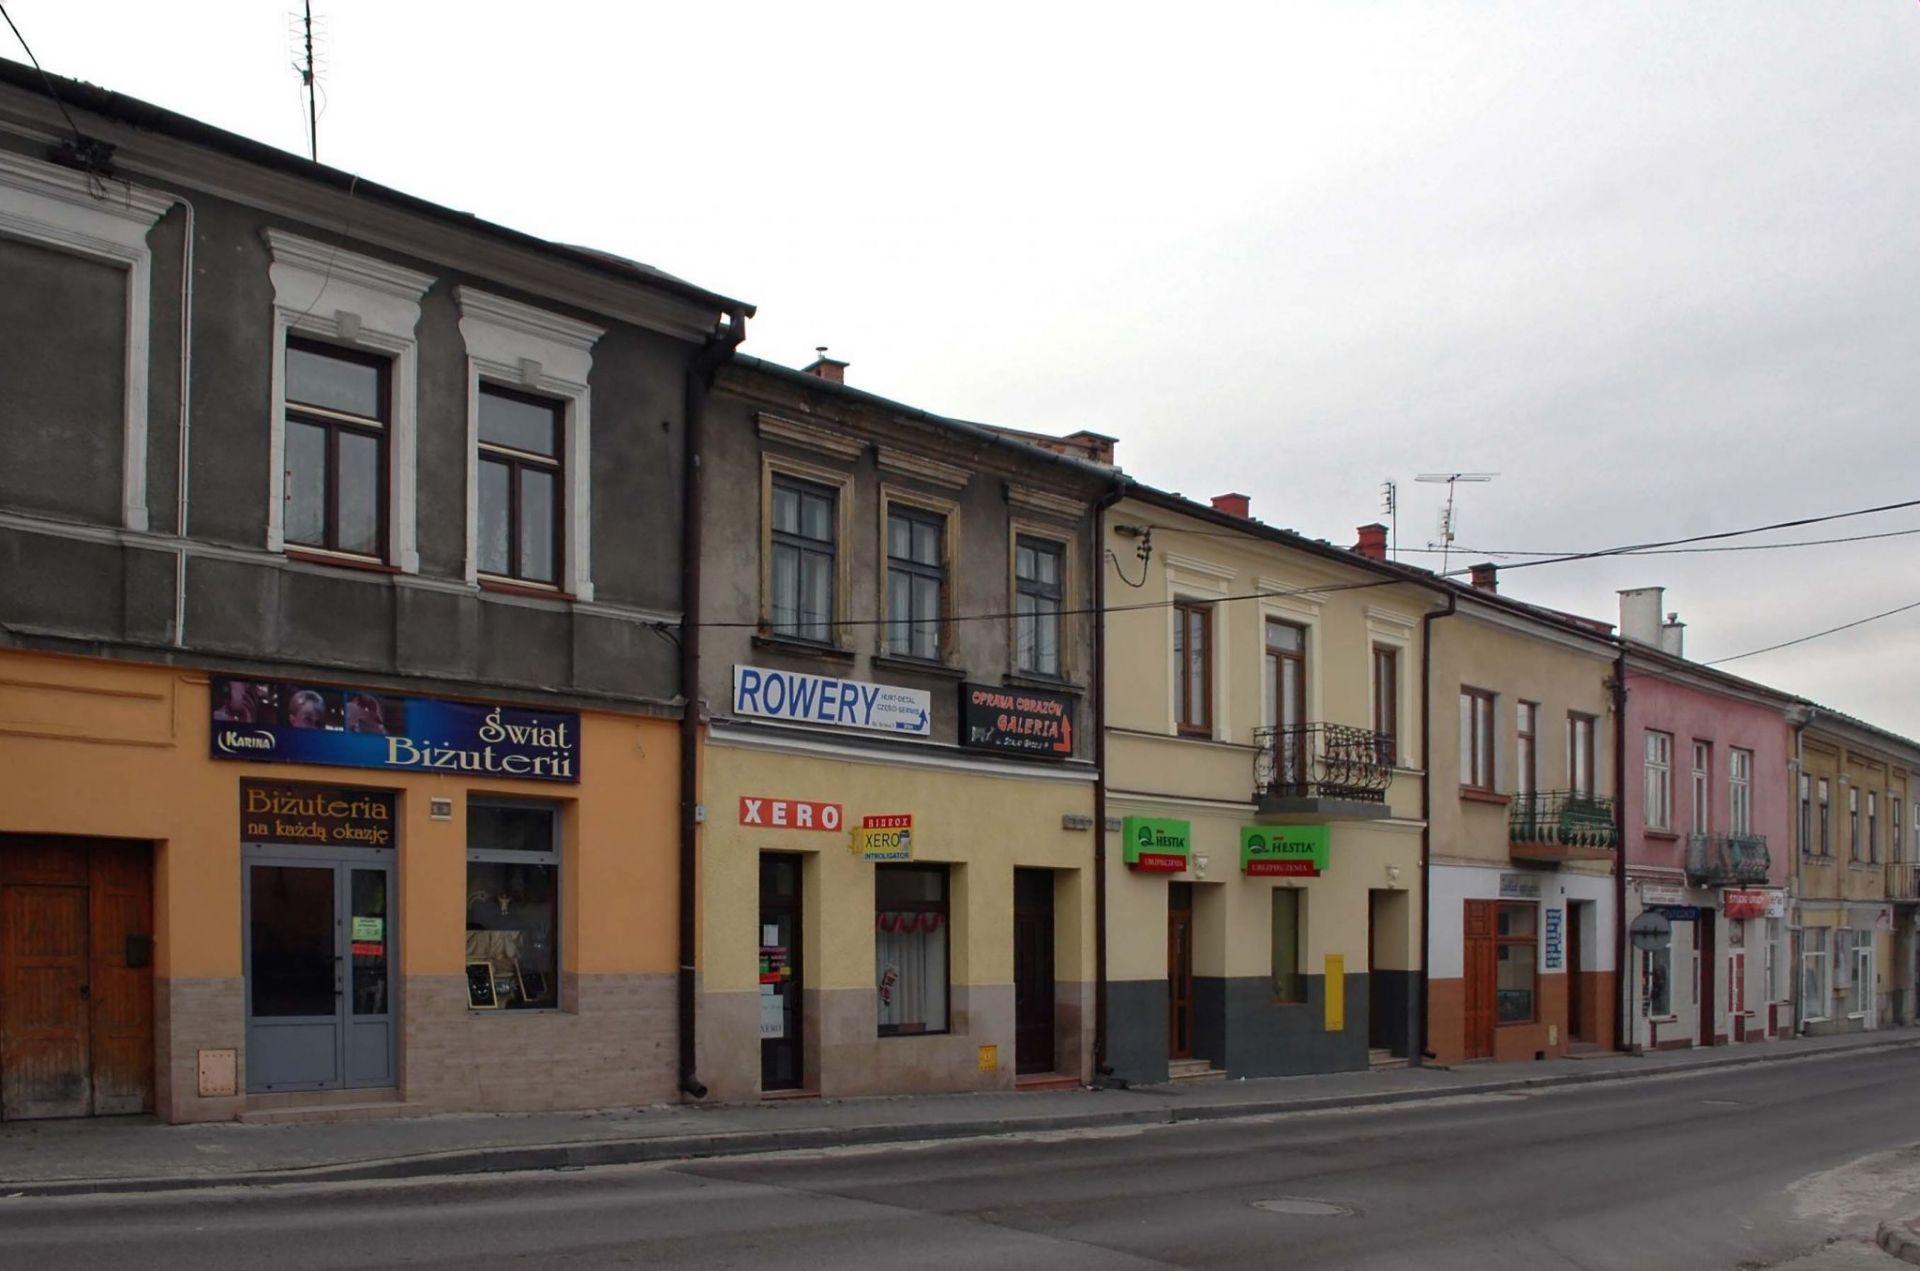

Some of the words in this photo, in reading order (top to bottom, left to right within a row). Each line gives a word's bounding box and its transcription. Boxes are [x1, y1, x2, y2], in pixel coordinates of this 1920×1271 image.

[738, 669, 880, 725] ROWERY
[972, 690, 1014, 710] OPRAWA
[1016, 697, 1063, 716] OBRAZÓW
[478, 705, 573, 750] Świat
[997, 713, 1059, 738] GALERIA
[384, 735, 574, 778] Biżuterii
[247, 787, 389, 820] Biżuteria
[744, 800, 839, 829] XERO
[247, 820, 268, 836] na
[275, 819, 327, 842] każdą
[333, 824, 390, 844] okazję
[865, 832, 900, 848] XERO
[1156, 835, 1184, 847] HESTIA
[1272, 842, 1313, 853] HESTIA
